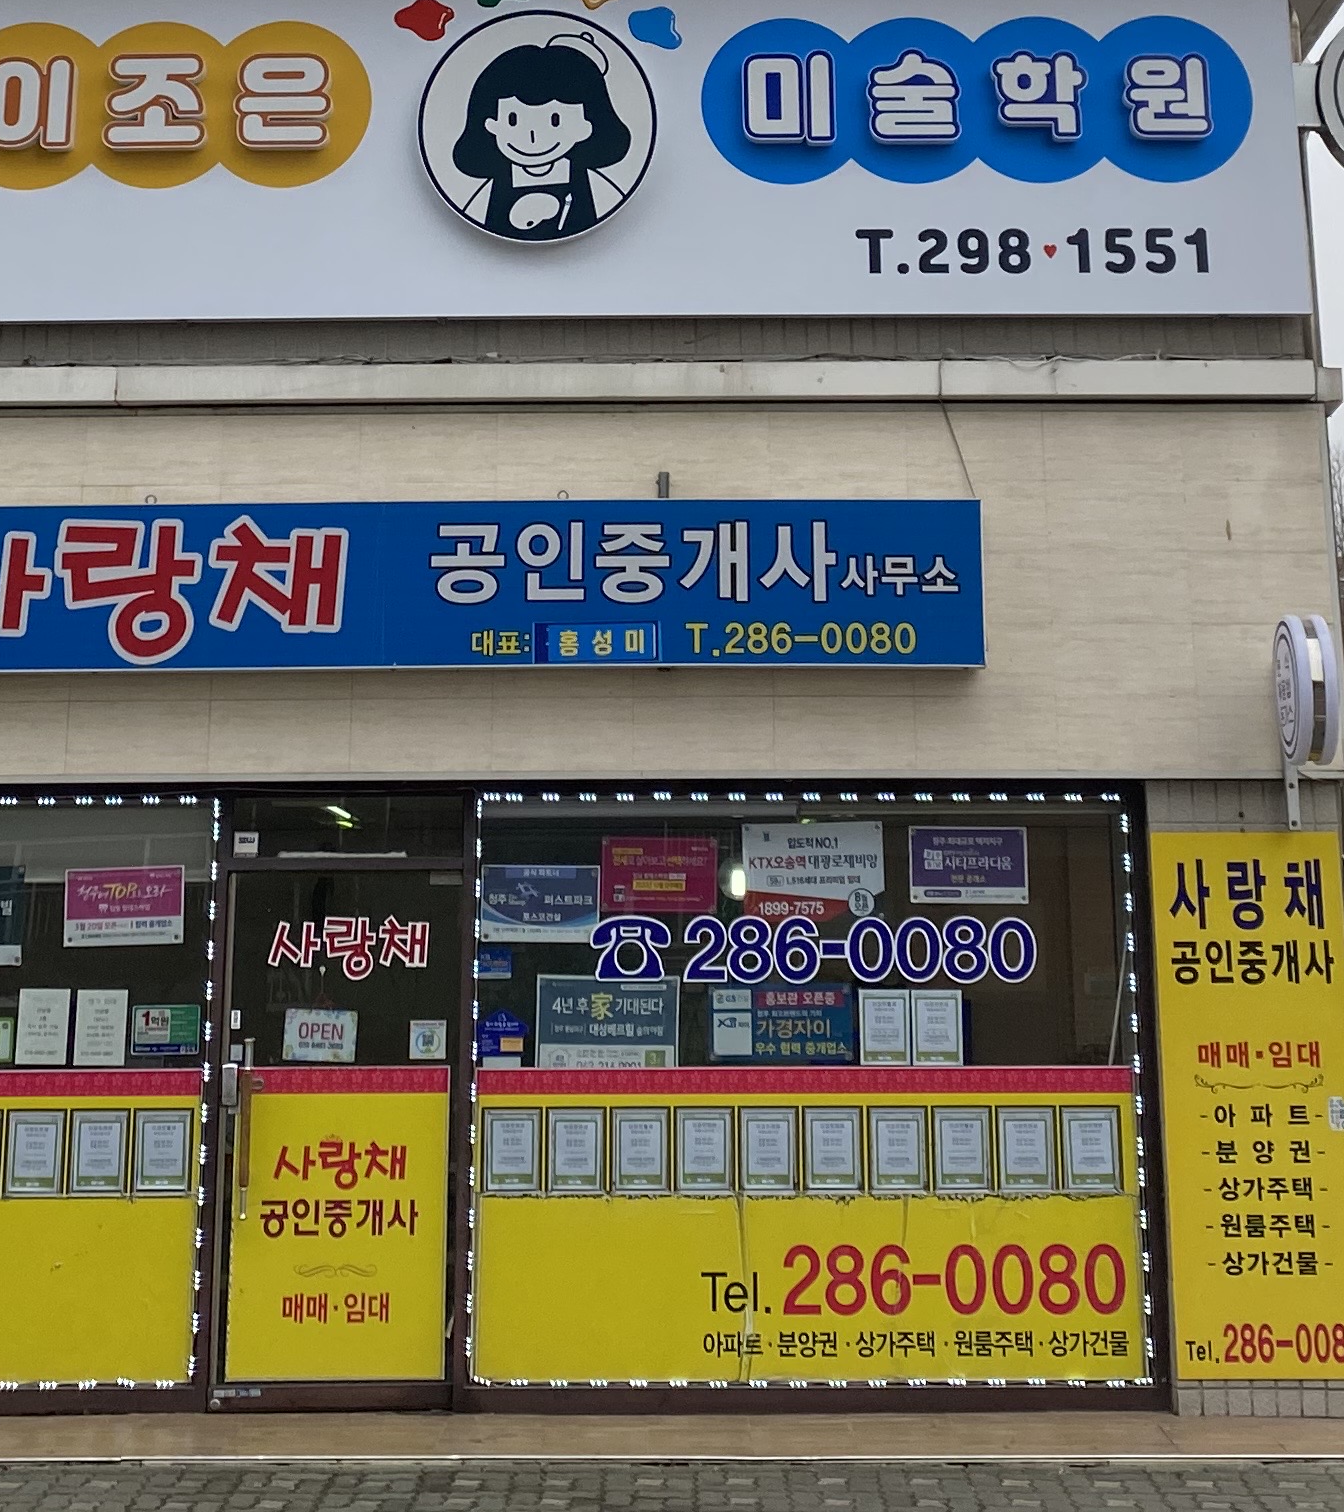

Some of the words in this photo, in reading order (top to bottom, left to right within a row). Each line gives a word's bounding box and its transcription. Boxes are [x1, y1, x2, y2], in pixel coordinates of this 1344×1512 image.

[742, 49, 1213, 147] 미술학원
[428, 518, 837, 605] 공인중개사
[841, 554, 960, 595] 사무소
[471, 630, 531, 657] 대표:
[558, 630, 646, 658] 홍성미
[684, 621, 918, 658] T.286-0080
[808, 854, 878, 869] 대광로제비앙
[1169, 858, 1326, 930] 사랑채
[267, 914, 430, 980] 사랑채
[683, 916, 1037, 983] 286-0080
[1170, 938, 1336, 986] 공인중개사
[552, 997, 574, 1014] 4년
[615, 997, 664, 1015] 기대된다
[298, 1022, 344, 1040] OPEN
[757, 1019, 831, 1039] 가경자이
[272, 1140, 408, 1190] 사랑채
[1218, 1175, 1315, 1202] 상가주택
[258, 1197, 420, 1239] 공인중개사
[1219, 1212, 1317, 1239] 원룸주택
[701, 1272, 773, 1314] Tel.
[783, 1243, 1126, 1317] 286-0080
[1221, 1250, 1319, 1277] 상가건물
[702, 1331, 763, 1358] 아파트
[777, 1330, 839, 1357] 분양권
[856, 1330, 936, 1357] 상가주택
[954, 1330, 1034, 1357] 원룸주택
[1049, 1330, 1129, 1358] 상가건물
[1185, 1339, 1220, 1365] Tel.
